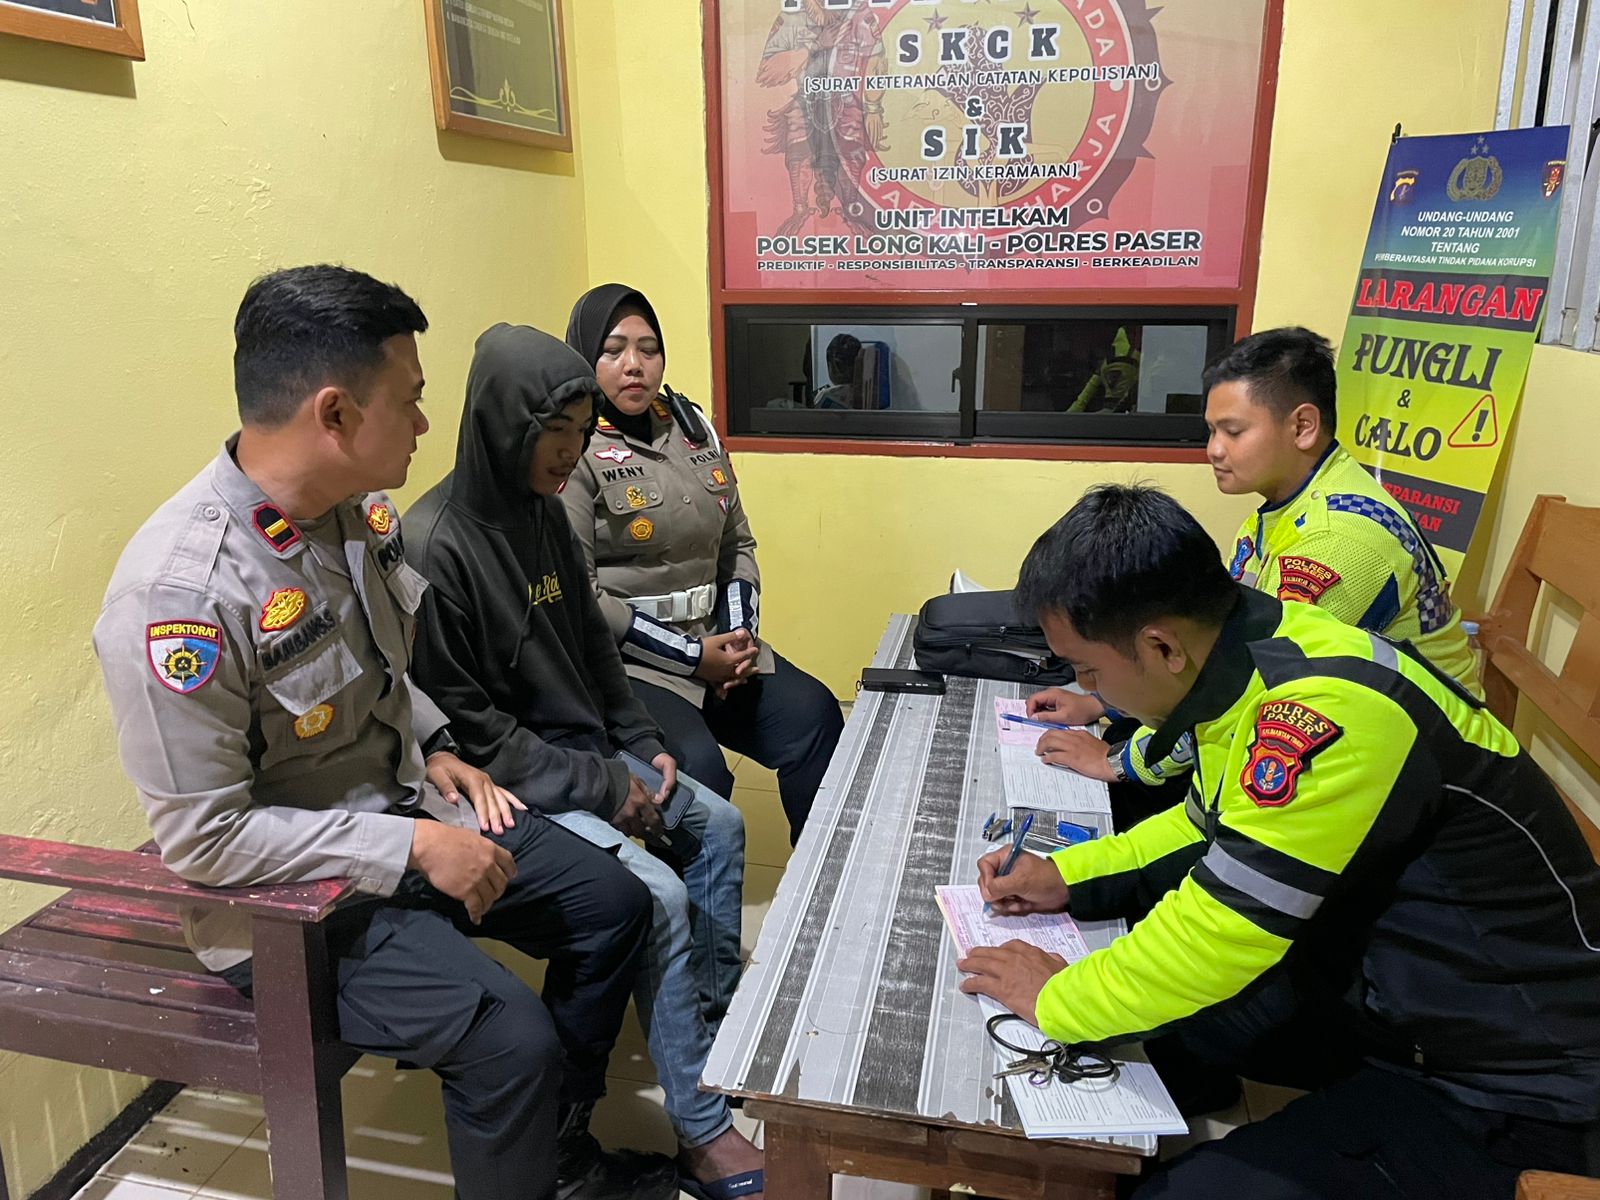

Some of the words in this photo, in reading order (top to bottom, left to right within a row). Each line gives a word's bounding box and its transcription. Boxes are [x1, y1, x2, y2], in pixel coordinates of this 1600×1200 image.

[805, 77, 860, 93] (SURAT
[866, 73, 970, 89] KETERANGAN
[977, 70, 1041, 85] CATATAN
[1048, 64, 1159, 82] KEPOLISIAN)
[966, 98, 983, 117] &
[872, 167, 927, 183] (SURAT
[933, 167, 968, 180] IZIN
[974, 163, 1078, 179] KERAMAIAN)
[876, 209, 934, 229] UNIT
[940, 206, 1069, 228] INTELKAM
[1417, 211, 1514, 223] UNDANG-UNDANG
[1401, 226, 1440, 237] NOMOR
[1442, 227, 1455, 238] 20
[1457, 227, 1494, 238] TAHUN
[1495, 227, 1521, 239] 2001
[757, 237, 849, 256] POLSEK
[855, 235, 922, 255] LONG
[929, 234, 984, 254] KALI
[1008, 233, 1107, 252] POLRES
[1115, 231, 1201, 251] PASER
[1430, 242, 1480, 254] TENTANG
[757, 261, 825, 270] PREDIKTIF
[837, 260, 956, 270] RESPONSIBILITAS
[969, 258, 1079, 269] TRANSPARANSI
[1092, 256, 1199, 267] BERKEADILAN
[1439, 256, 1467, 266] TINDAK
[1467, 257, 1497, 267] PIDANA
[1498, 258, 1537, 268] KORUPSI
[1355, 278, 1544, 322] LARANGAN
[1352, 333, 1503, 392] PUNGLI
[1396, 389, 1411, 408] &
[1354, 413, 1442, 461] CALO
[601, 465, 646, 482] WENY
[1382, 482, 1461, 515] SPARANSI
[1283, 558, 1333, 581] POLRES
[150, 623, 218, 639] INSPEKTORAT
[1262, 703, 1329, 734] POLRES
[1266, 712, 1316, 736] PASER
